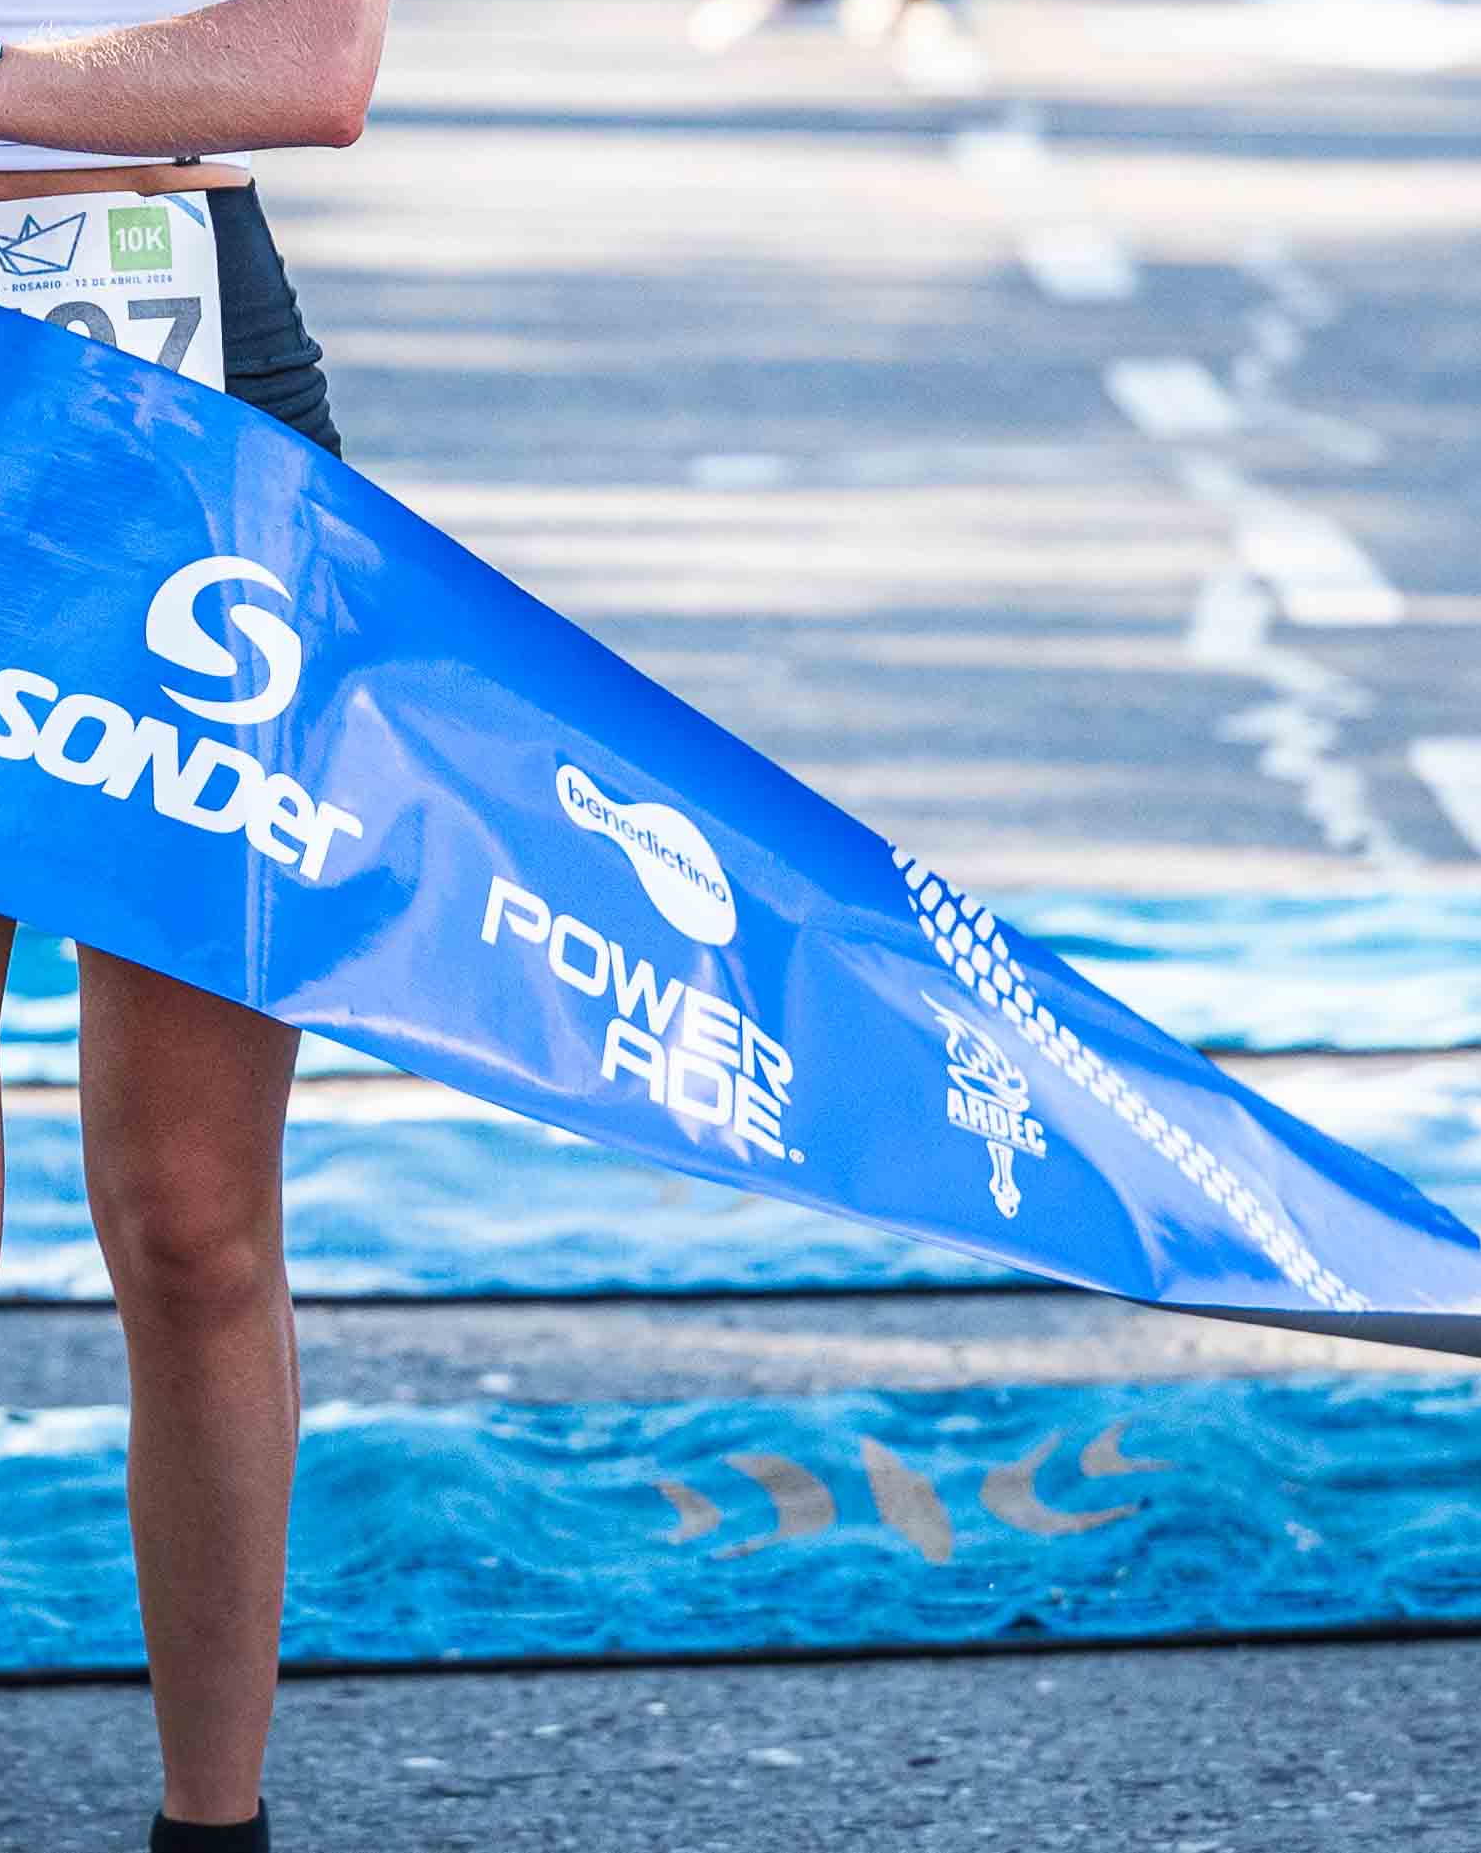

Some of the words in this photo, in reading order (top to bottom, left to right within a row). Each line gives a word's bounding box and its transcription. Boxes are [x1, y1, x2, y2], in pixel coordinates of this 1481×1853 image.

[115, 227, 166, 253] 10K
[11, 279, 62, 293] ROSARIO
[91, 277, 107, 287] DE
[109, 275, 142, 286] ABRIL
[567, 777, 727, 903] benedictino
[480, 875, 794, 1106] POWER
[947, 1086, 1047, 1152] ARDEC
